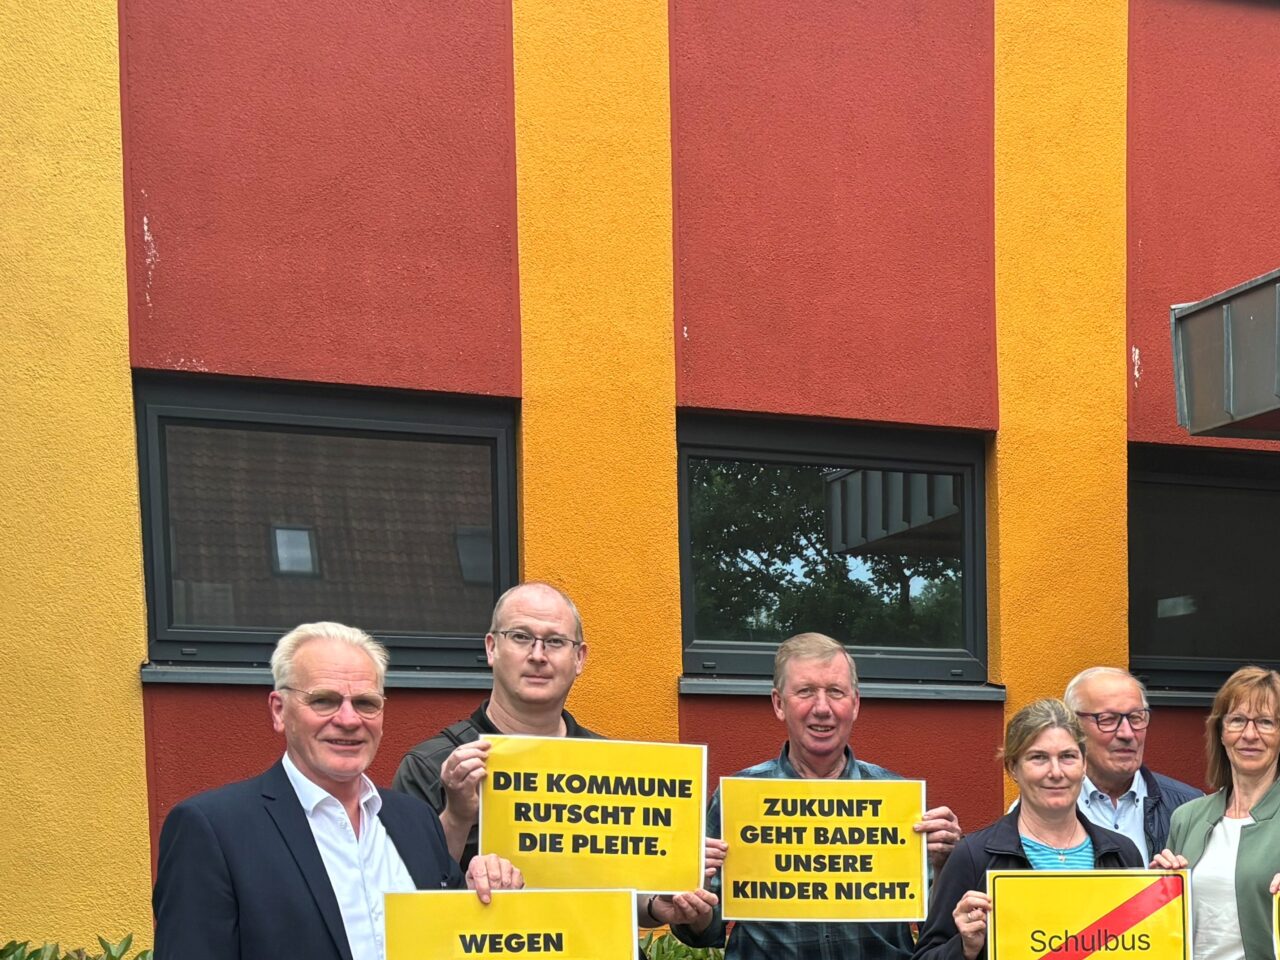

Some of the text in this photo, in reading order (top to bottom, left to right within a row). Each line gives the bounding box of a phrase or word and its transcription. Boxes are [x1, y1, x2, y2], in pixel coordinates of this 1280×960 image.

[493, 772, 692, 798] DIE KOMMUNE
[514, 802, 672, 827] RUTSCHT IN
[763, 798, 883, 817] ZUKUNFT
[519, 832, 667, 856] DIE PLEITE.
[740, 825, 906, 845] GEHT BADEN.
[775, 854, 873, 873] UNSERE
[732, 880, 915, 900] KINDER NICHT.
[459, 932, 563, 954] WEGEN
[1030, 928, 1151, 953] Schulbus
